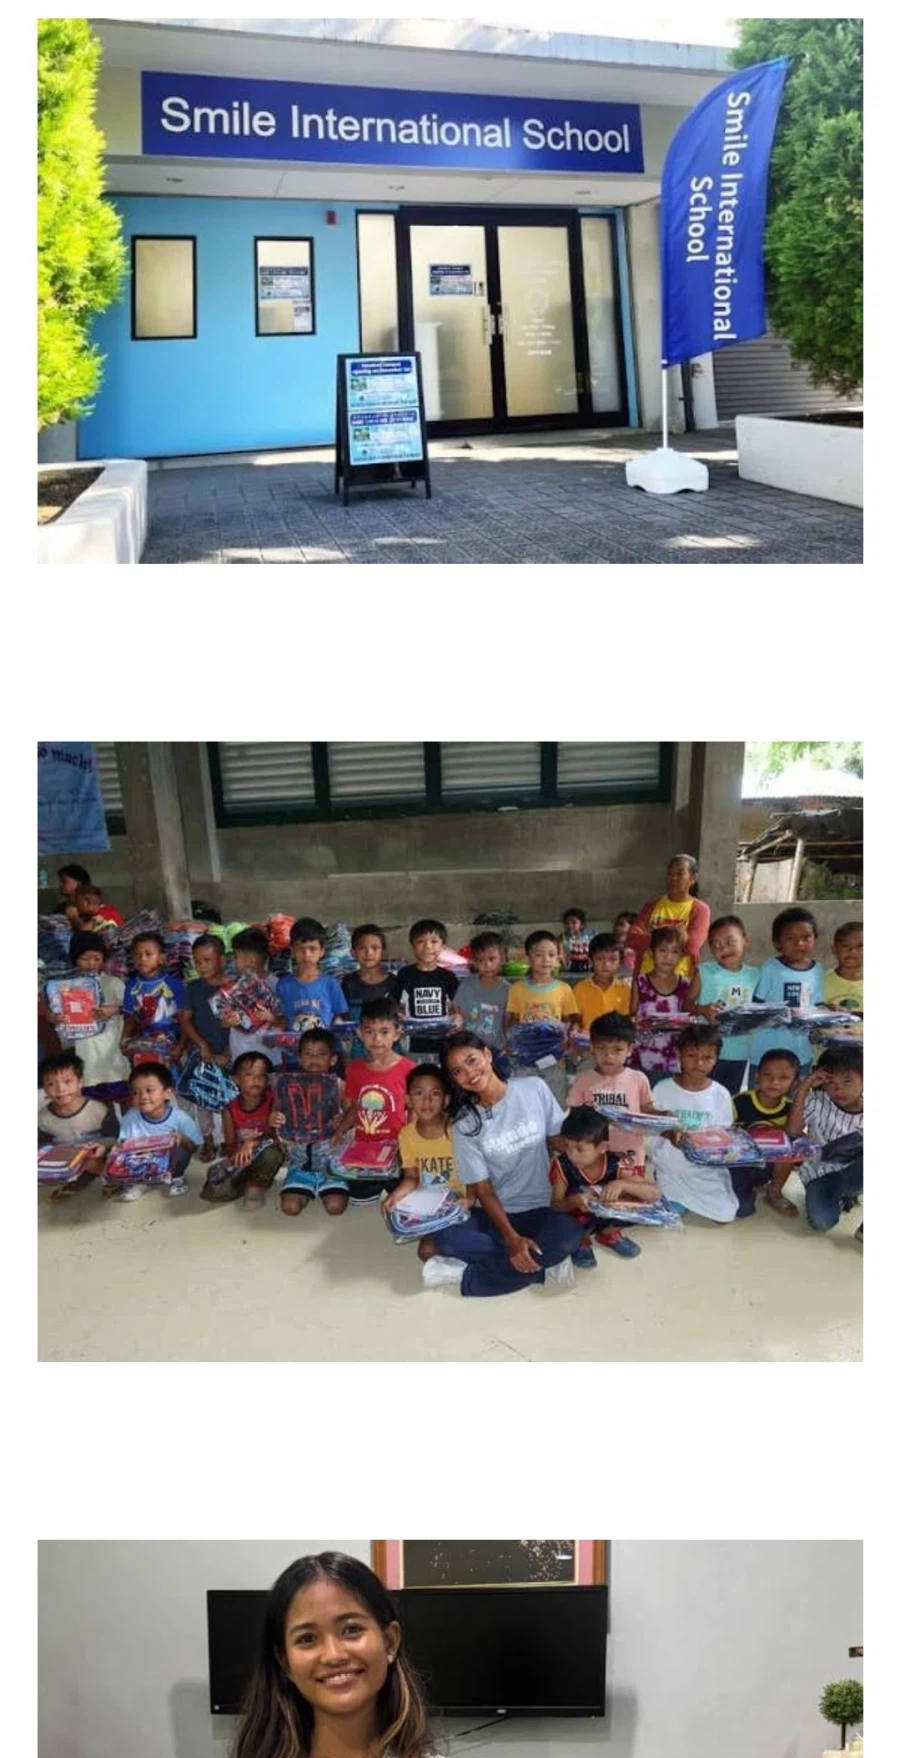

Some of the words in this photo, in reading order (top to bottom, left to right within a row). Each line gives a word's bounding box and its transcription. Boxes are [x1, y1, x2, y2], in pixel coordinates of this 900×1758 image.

[160, 96, 276, 138] Smile
[290, 104, 511, 149] International
[522, 118, 630, 154] School
[722, 91, 751, 166] Smile
[686, 176, 713, 263] School
[712, 173, 744, 341] International
[415, 988, 442, 999] NAVY
[416, 1004, 442, 1015] BLUE
